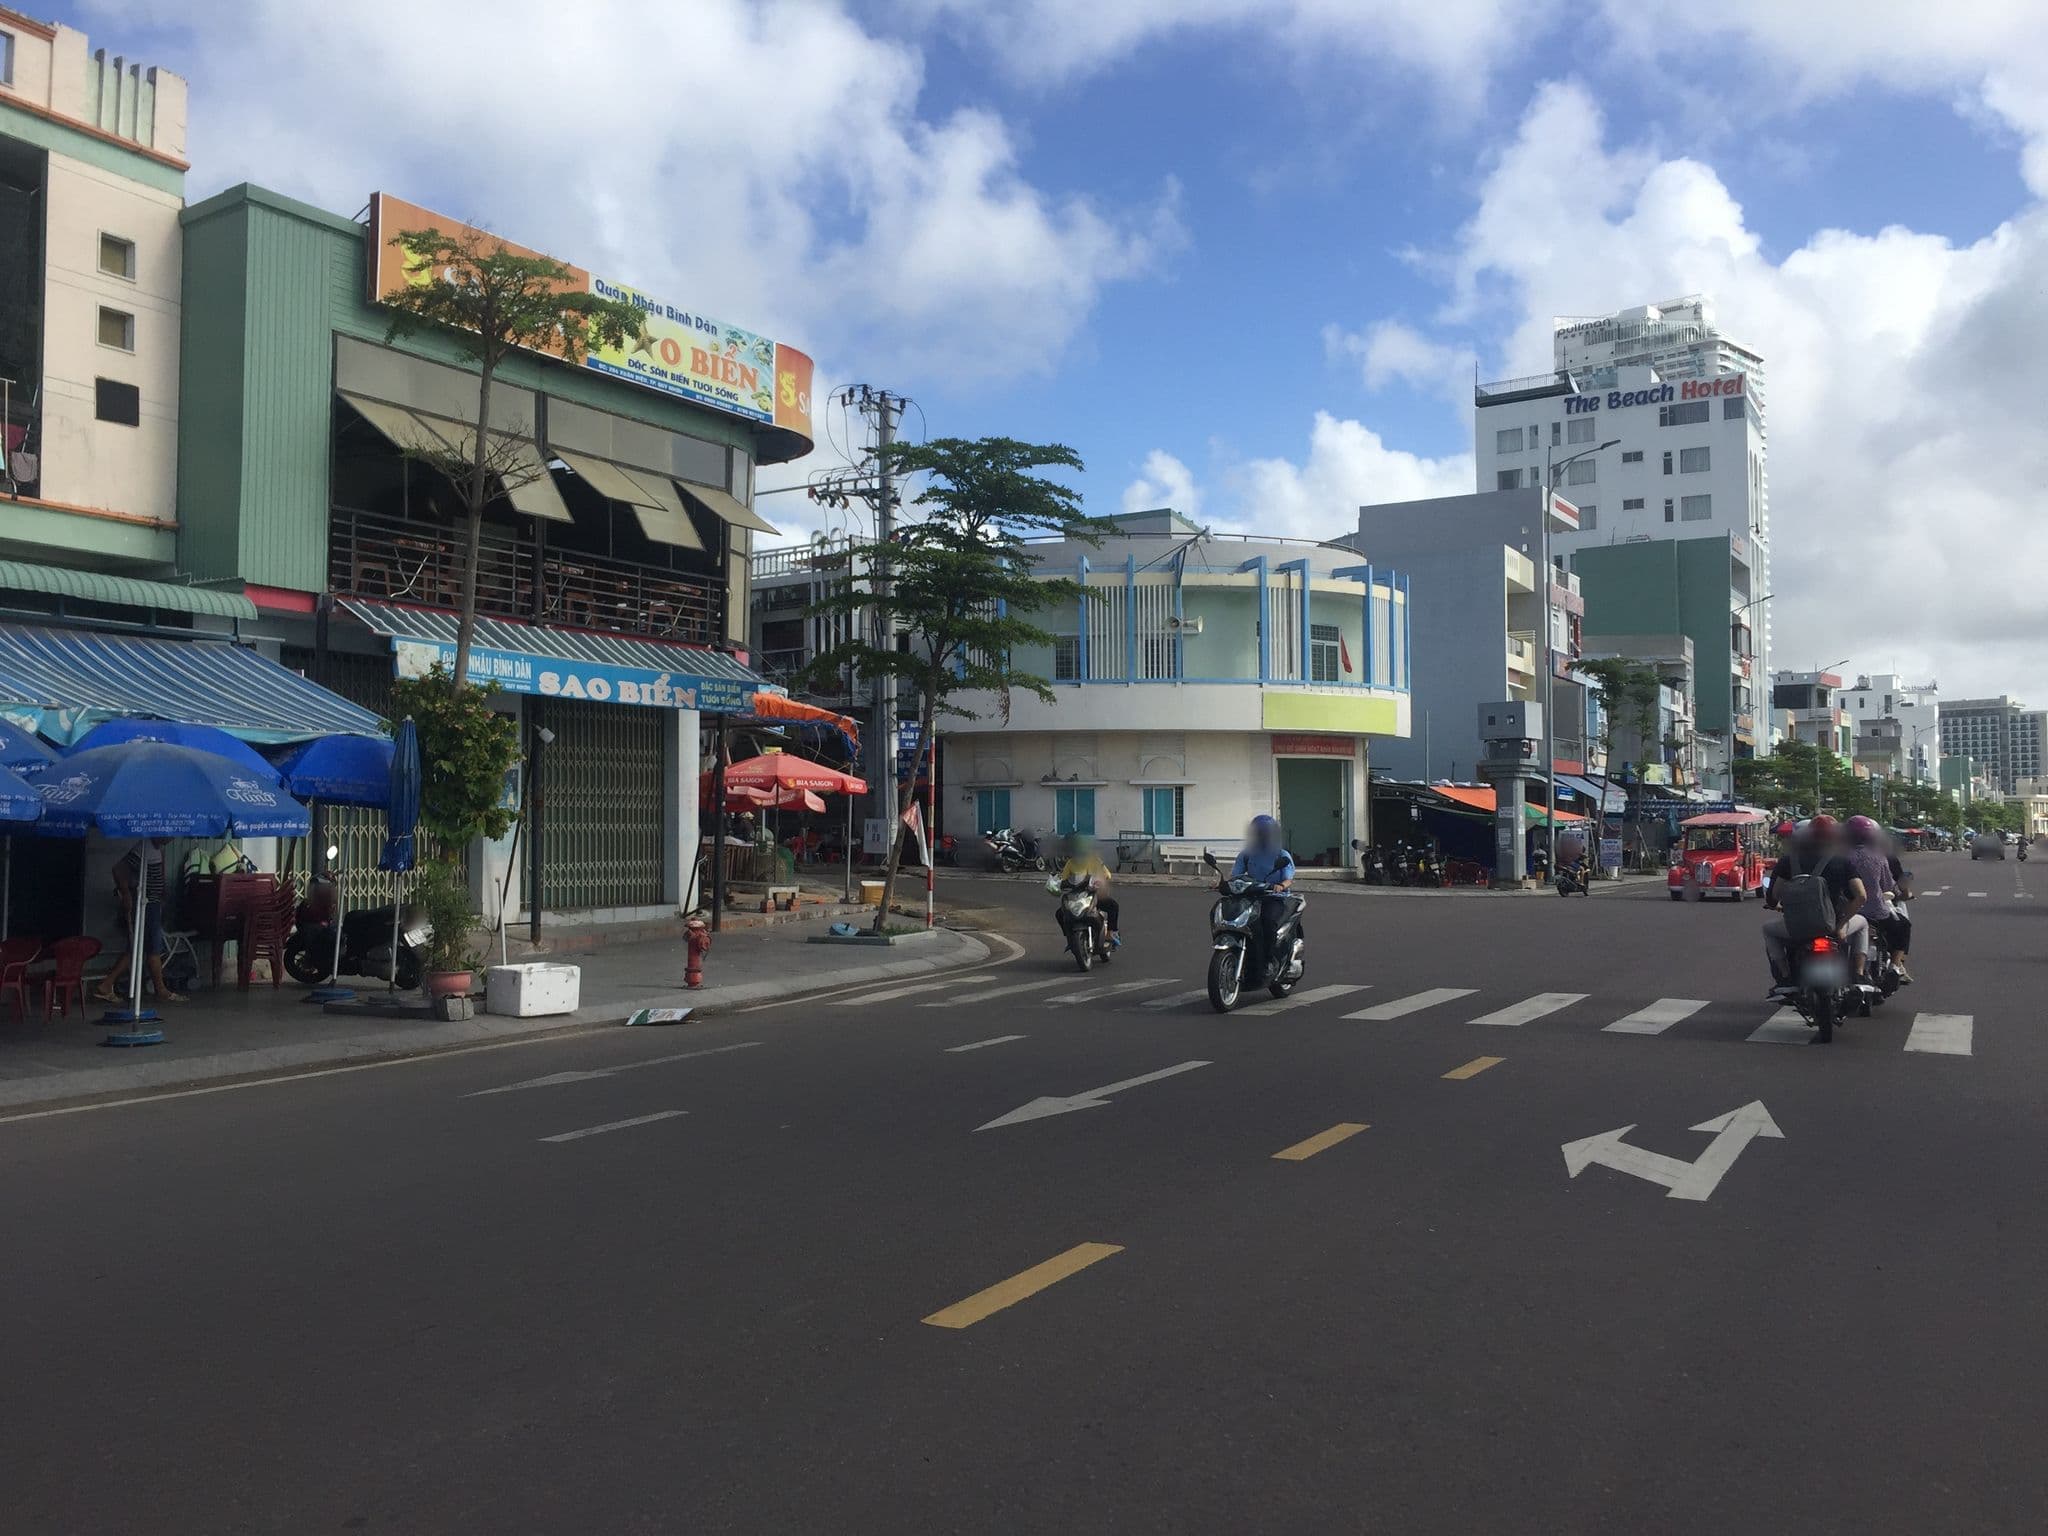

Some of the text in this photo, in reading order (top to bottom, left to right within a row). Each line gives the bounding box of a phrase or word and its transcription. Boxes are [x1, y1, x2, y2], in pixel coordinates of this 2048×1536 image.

[690, 343, 758, 392] BIỂN
[1563, 374, 1744, 415] The Beach Hotel
[538, 671, 697, 709] SAO BIỂN
[809, 780, 834, 788] SAIGON
